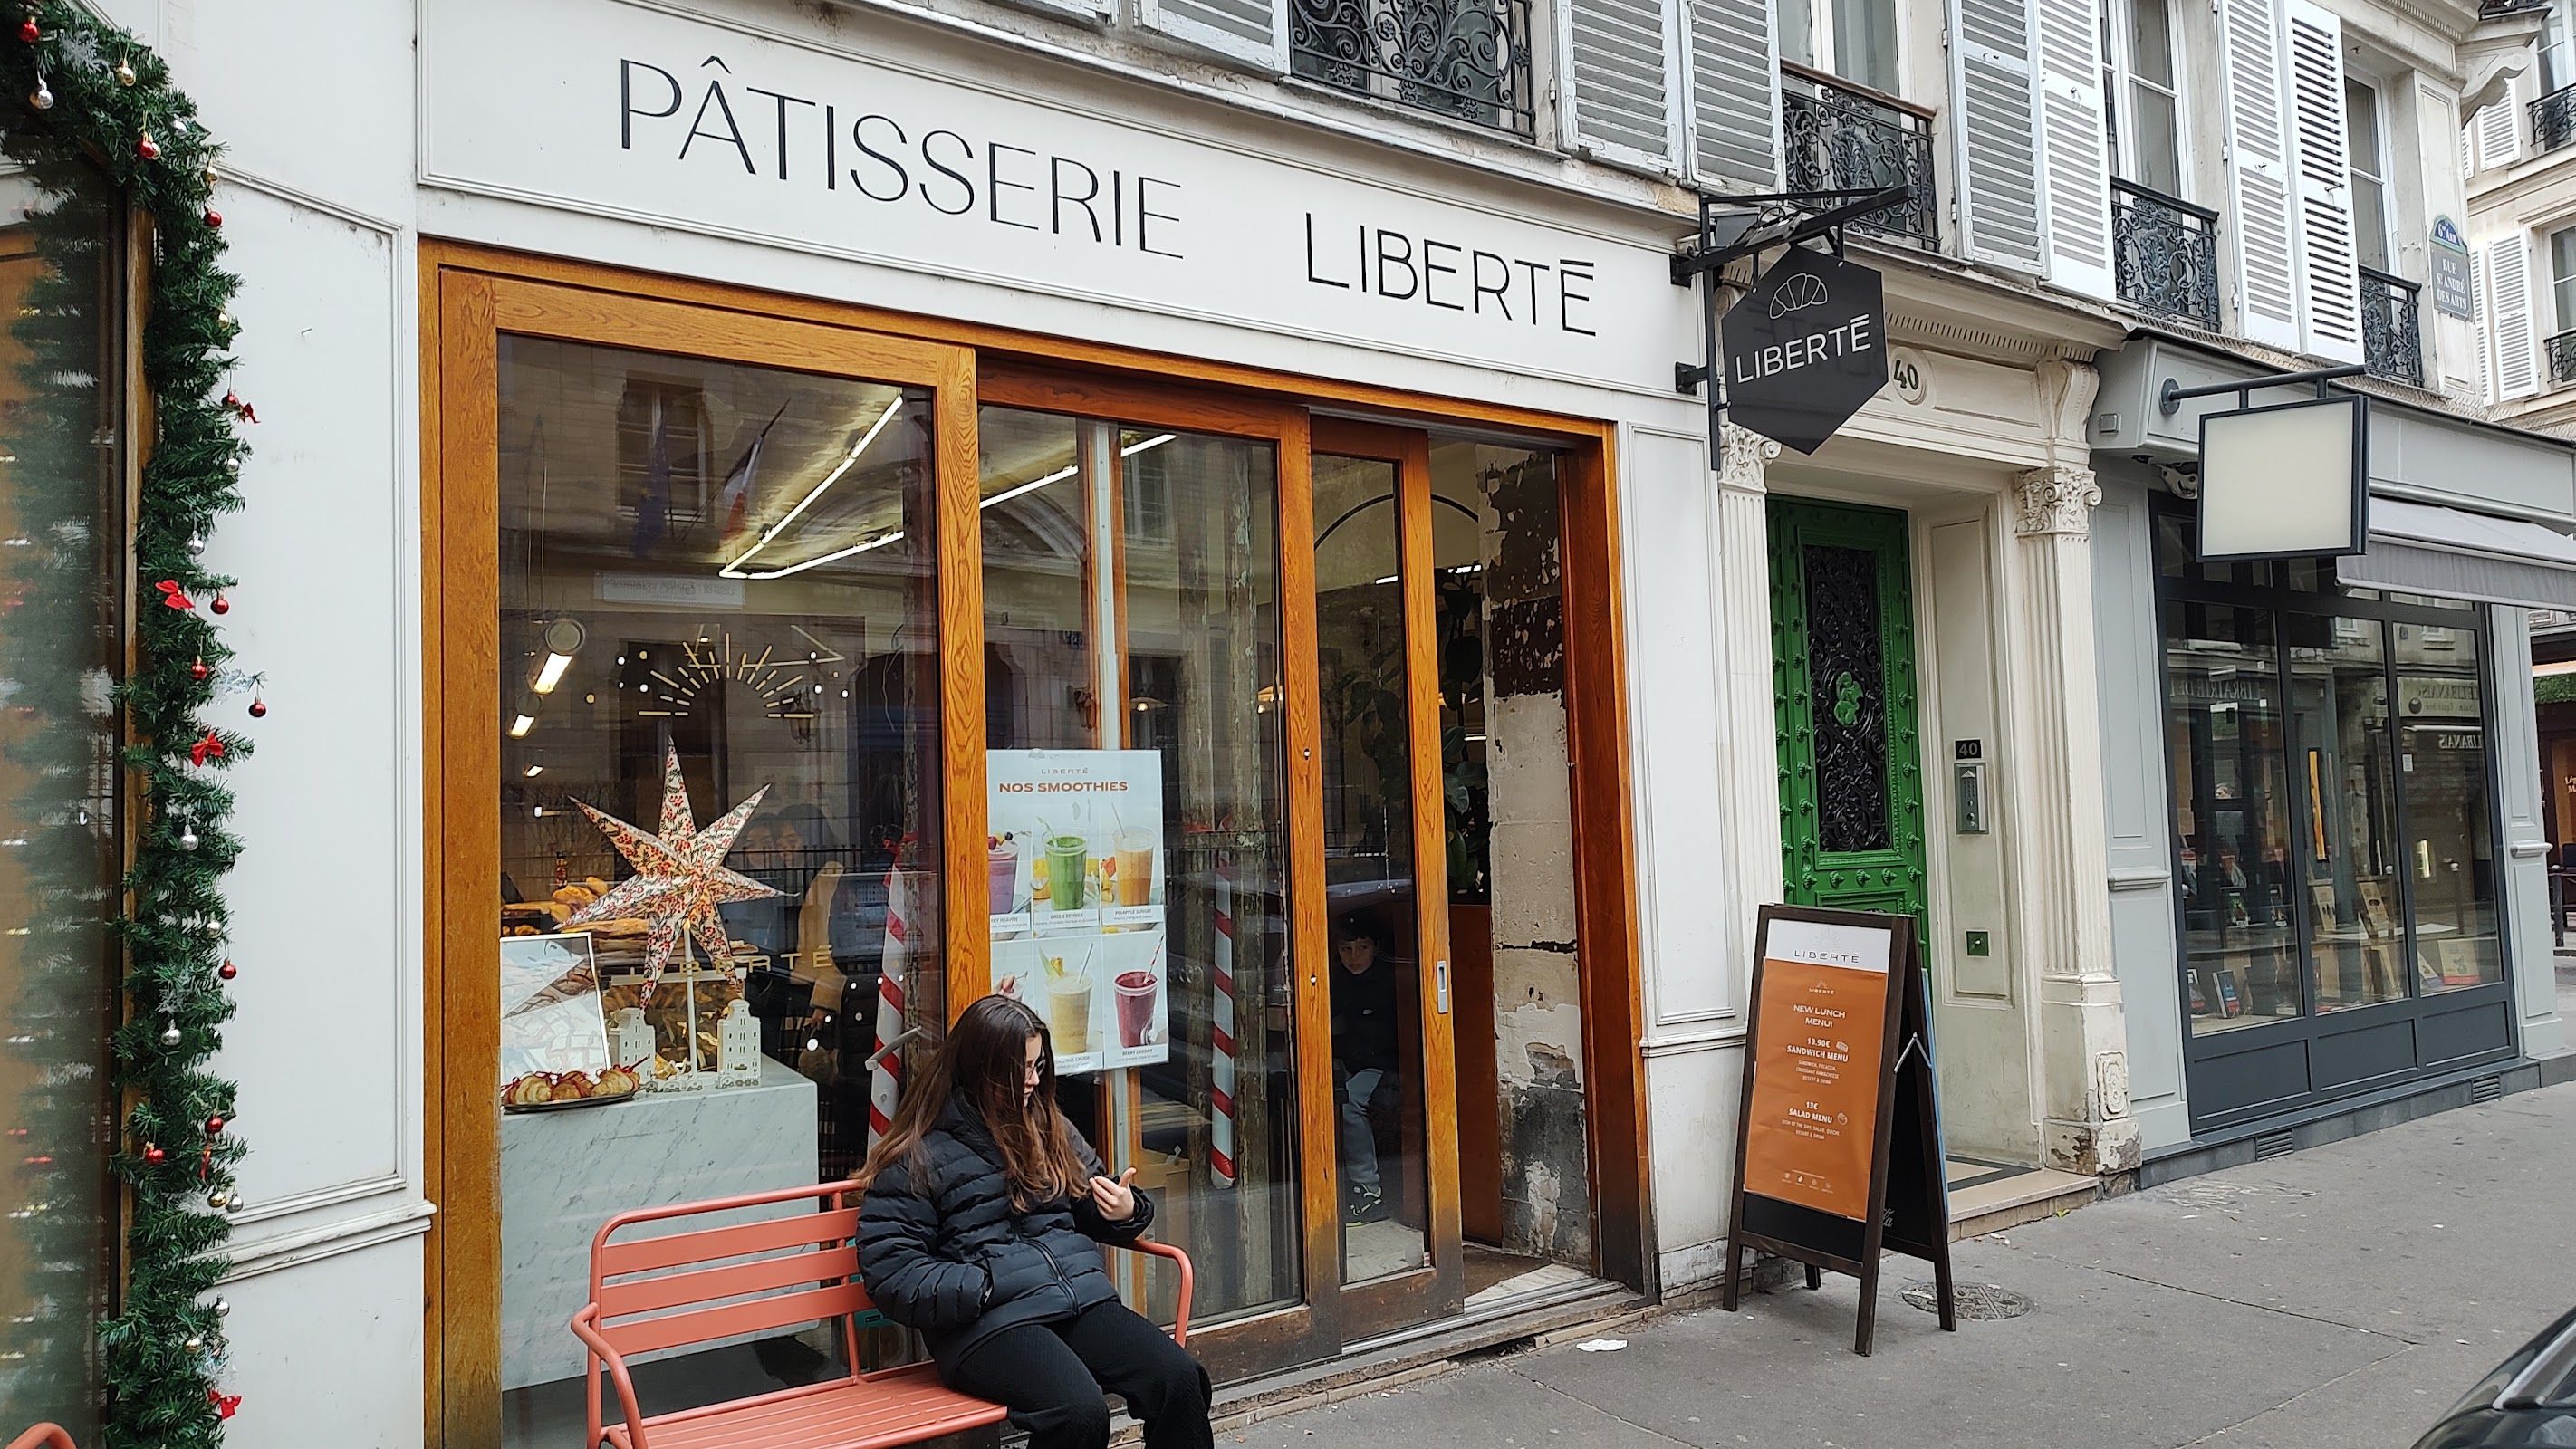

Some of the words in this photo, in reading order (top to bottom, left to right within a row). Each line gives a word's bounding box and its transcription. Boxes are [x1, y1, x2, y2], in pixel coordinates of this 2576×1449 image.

[620, 55, 1183, 260] PÂTISSERIE
[1305, 212, 1597, 338] LIBERTÉ
[2442, 258, 2457, 275] RUE
[2444, 275, 2465, 293] ANDRÉ
[2437, 288, 2450, 304] DES
[2450, 293, 2467, 311] ARTS
[1735, 313, 1871, 384] LIBERTÉ
[1893, 359, 1919, 390] 40
[1958, 743, 1978, 756] 40
[999, 783, 1033, 793] NOS
[1037, 782, 1129, 792] SMOOTHIES
[630, 945, 832, 983] LBERTÉ
[1794, 950, 1860, 964] LIBERTÉ
[1793, 1003, 1814, 1013] NEW
[1814, 1007, 1846, 1018] LUNCH
[1805, 1017, 1833, 1028] MENU!
[1807, 1037, 1831, 1048] 10.90€
[1786, 1045, 1826, 1059] SANDWICH
[1827, 1051, 1849, 1062] MENU
[1806, 1101, 1819, 1110] 13€
[1788, 1108, 1811, 1118] SALAD
[1812, 1113, 1833, 1123] MENU
